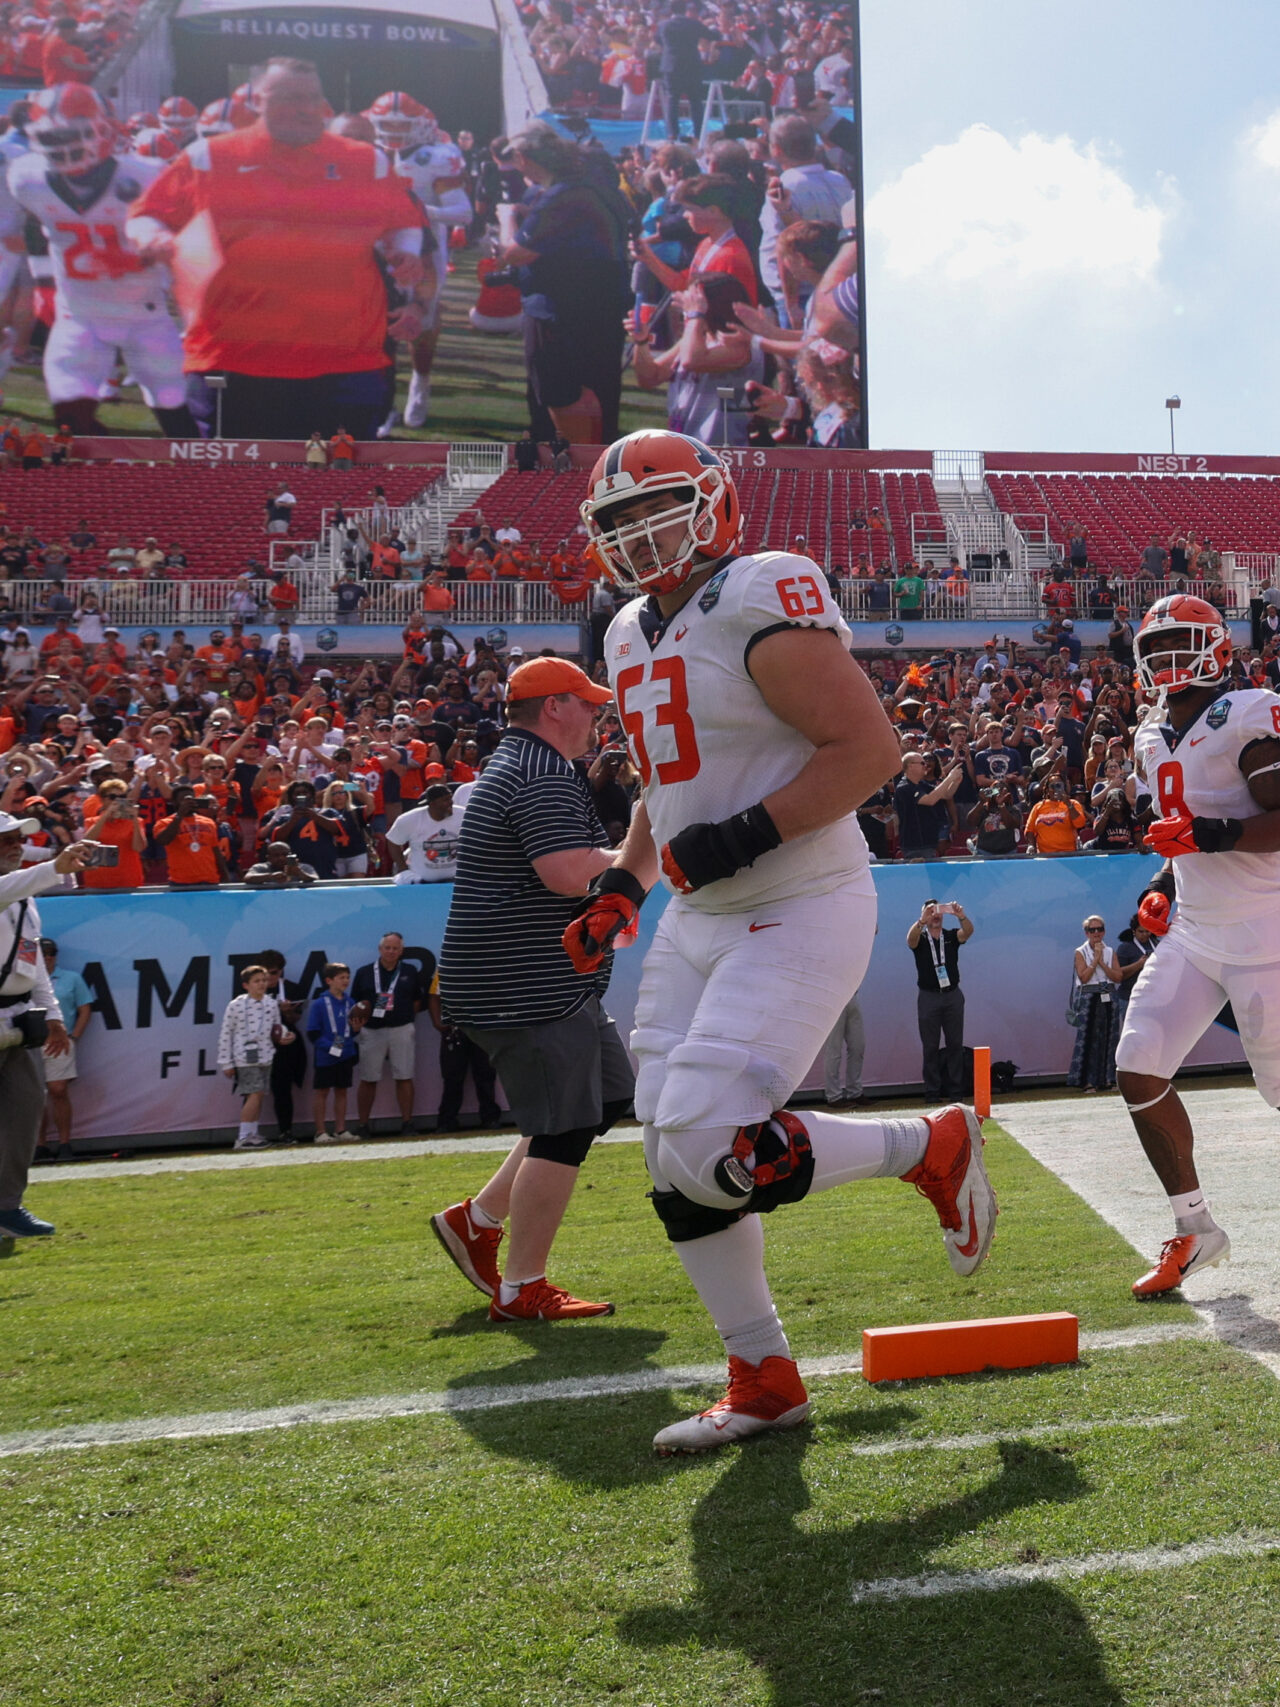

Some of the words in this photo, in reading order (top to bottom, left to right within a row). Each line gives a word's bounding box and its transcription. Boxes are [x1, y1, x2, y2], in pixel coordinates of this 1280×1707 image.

[219, 18, 372, 40] RELIAQUEST
[386, 24, 451, 42] BOWL
[170, 441, 239, 460] NEST
[244, 443, 260, 460] 4
[718, 450, 747, 467] ST
[752, 450, 767, 467] 3
[1137, 456, 1191, 471] NEST
[1195, 457, 1208, 471] 2
[775, 575, 826, 618] 63
[617, 655, 701, 788] 63
[1157, 760, 1194, 818] 8
[299, 820, 319, 841] 4
[82, 949, 334, 1032] AMPA
